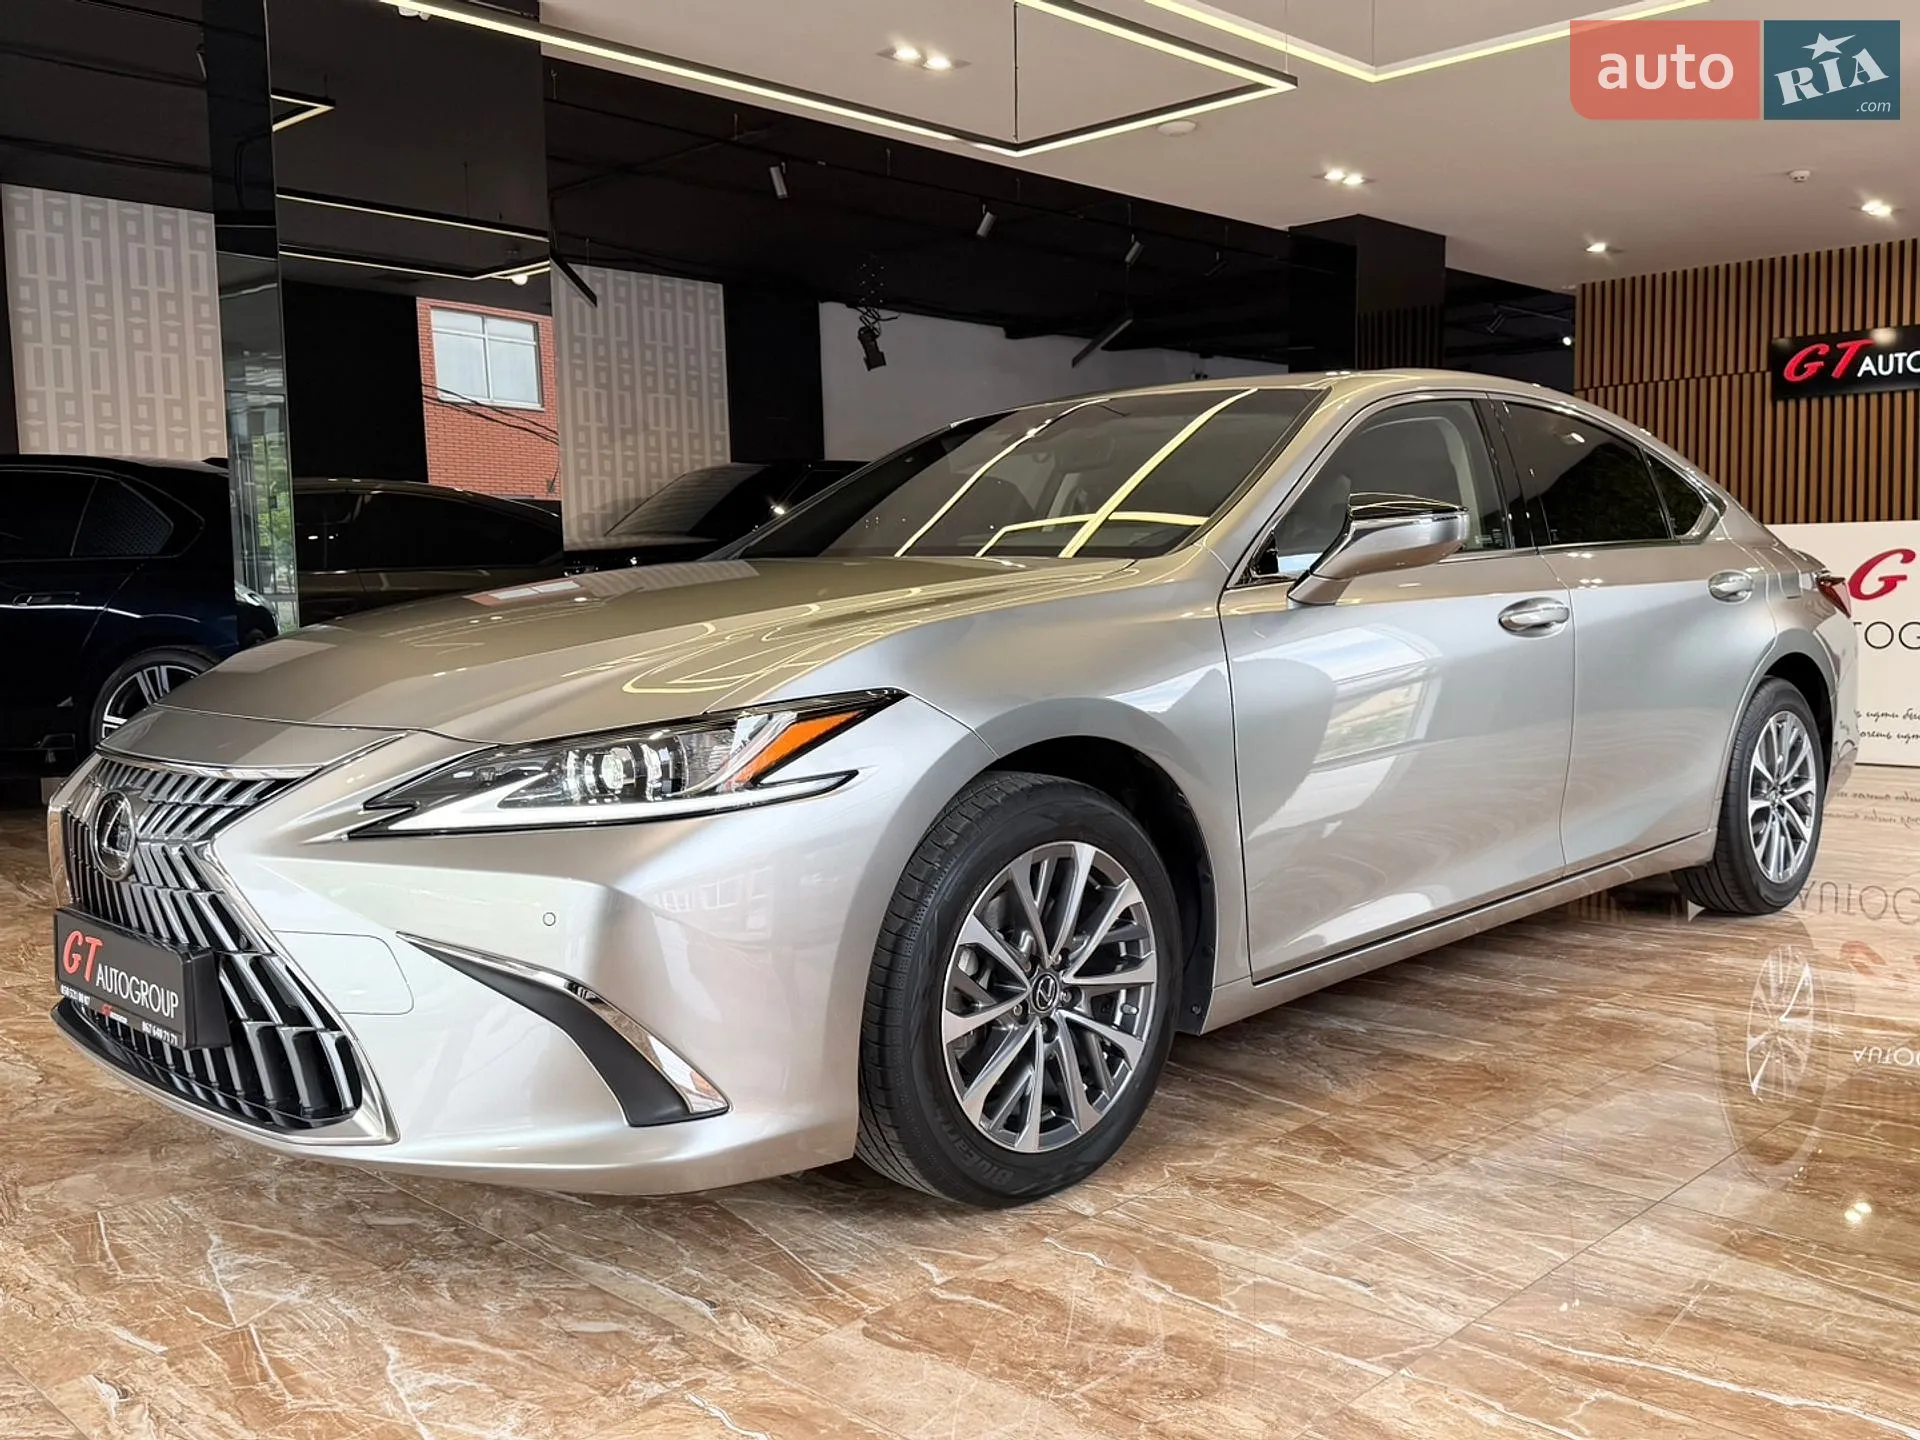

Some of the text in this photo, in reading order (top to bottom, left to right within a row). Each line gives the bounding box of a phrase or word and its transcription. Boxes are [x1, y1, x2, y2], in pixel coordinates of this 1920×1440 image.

[1783, 339, 1876, 383] GT
[62, 930, 104, 983] GT
[96, 963, 179, 1019] AUTOGROUP
